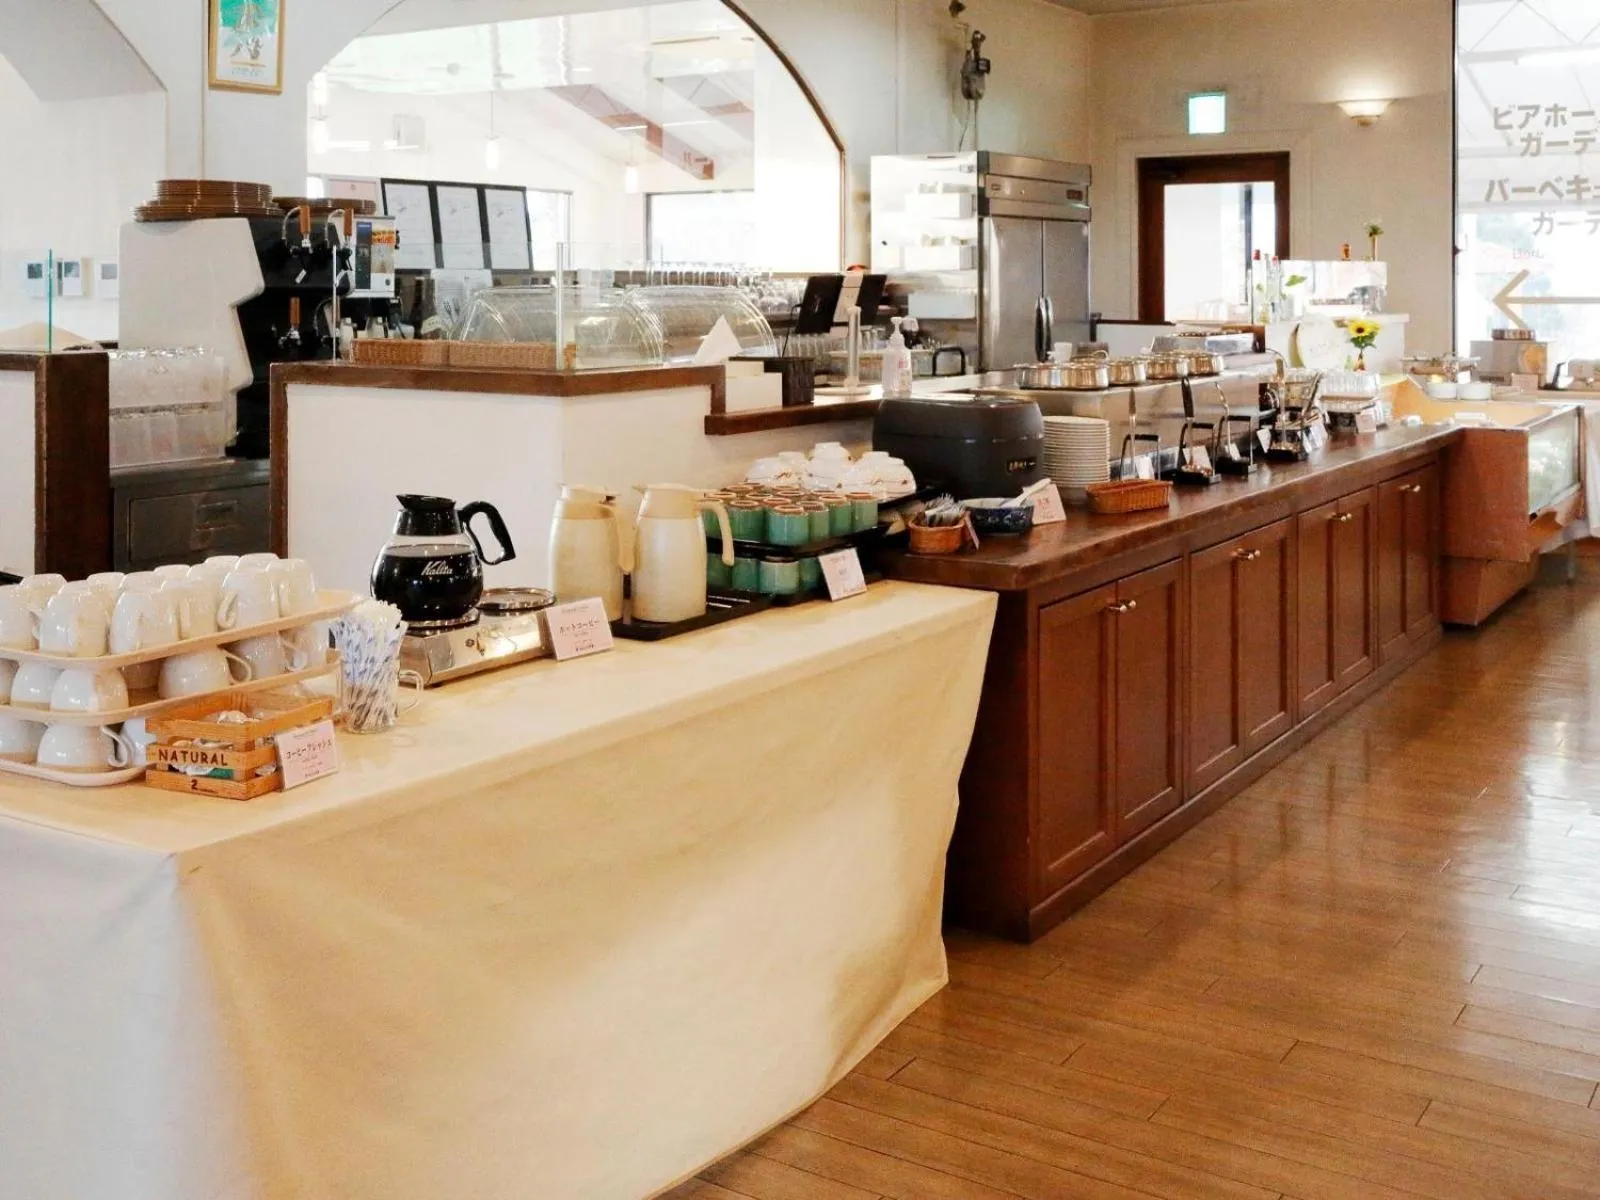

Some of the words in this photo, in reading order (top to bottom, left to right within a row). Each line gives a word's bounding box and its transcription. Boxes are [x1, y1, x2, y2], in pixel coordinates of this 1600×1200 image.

[1493, 104, 1600, 130] ビアホー
[421, 560, 453, 575] Kalita
[158, 749, 228, 766] NATURAL
